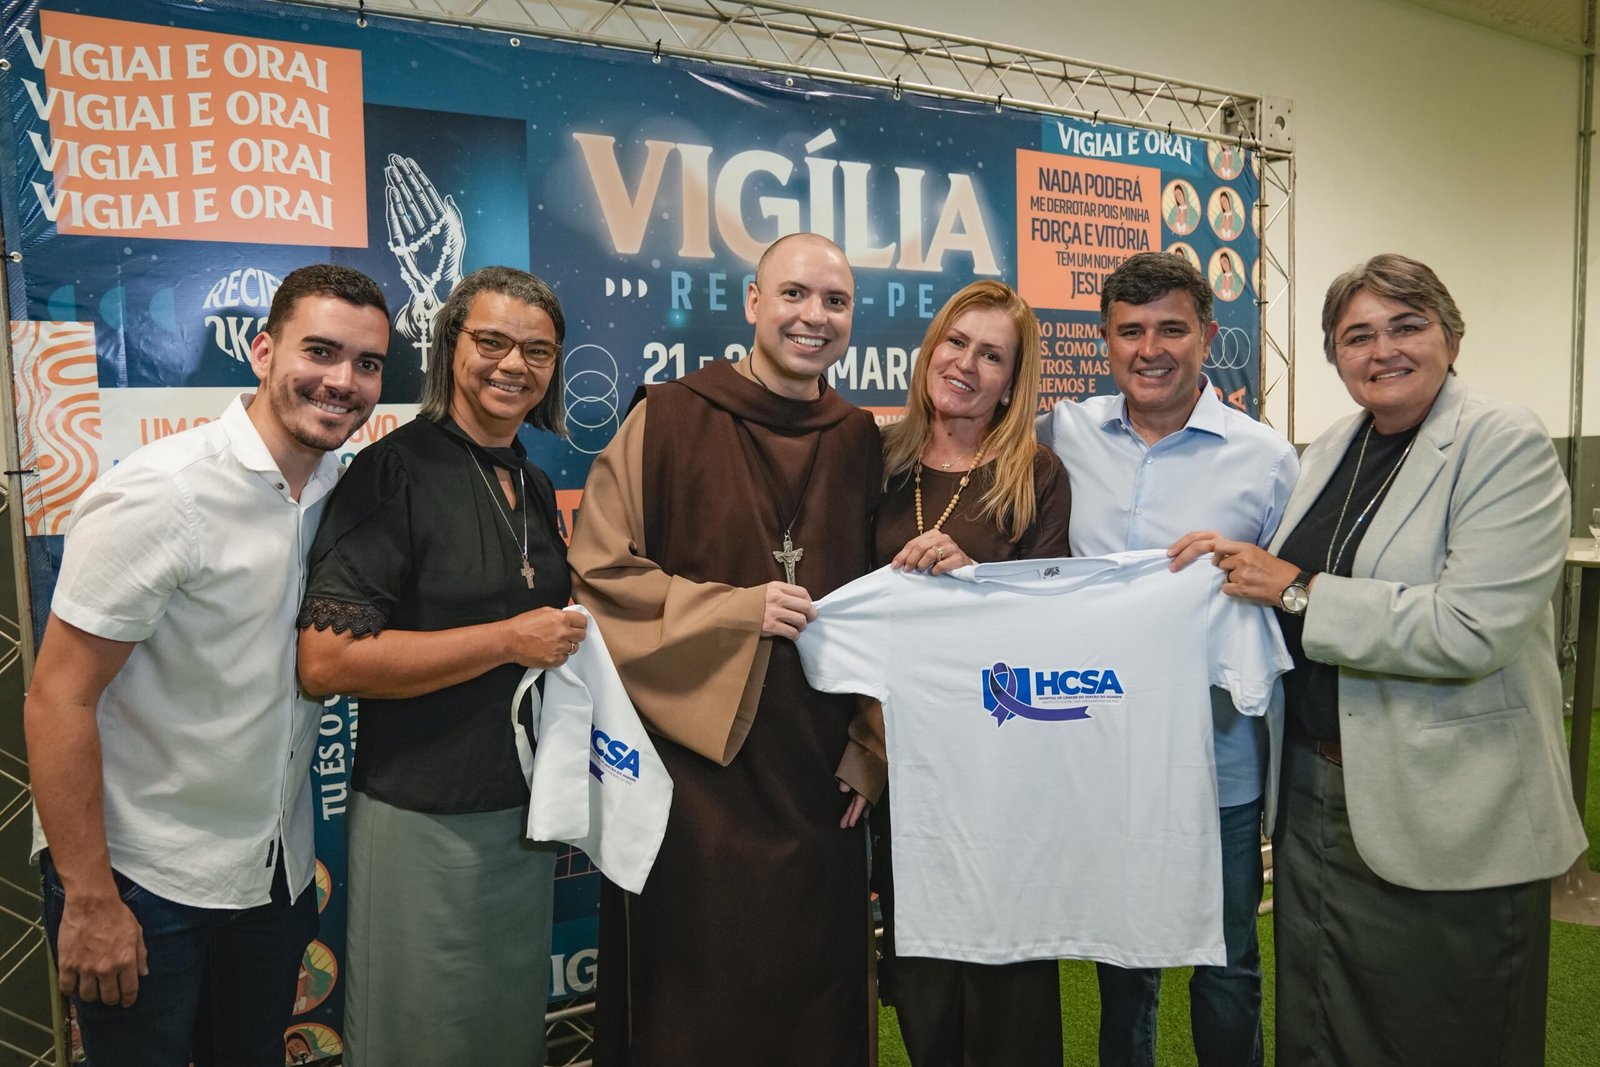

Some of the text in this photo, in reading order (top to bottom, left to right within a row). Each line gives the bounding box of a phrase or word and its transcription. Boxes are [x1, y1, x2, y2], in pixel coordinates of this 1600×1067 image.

[18, 26, 328, 94] VIGIAI E ORAI
[21, 78, 330, 139] VIGIAI E ORAI
[26, 131, 332, 185] VIGIAI E ORAI
[1057, 121, 1192, 165] VIGIAI E ORAI
[573, 128, 1001, 275] VIGÍLIA
[1039, 167, 1142, 202] NADA PODERÁ
[31, 182, 334, 231] VIGIAI E ORAI
[1030, 196, 1150, 223] ME DERROTAR POIS MINHA
[1031, 217, 1150, 251] FORÇA E VITÓRIA
[1056, 251, 1075, 266] TEM
[1077, 253, 1093, 268] UM
[1094, 254, 1121, 269] NOME
[1056, 322, 1101, 339] DURM
[643, 342, 686, 385] 21
[828, 346, 921, 390] MAR
[1055, 341, 1097, 357] COMO
[1039, 359, 1110, 376] TROS, MAS
[1088, 378, 1096, 393] E
[1035, 669, 1124, 696] HCSA
[319, 713, 343, 736] O
[313, 742, 345, 777] ÉS
[591, 723, 639, 779] CSA
[321, 781, 347, 821] TU
